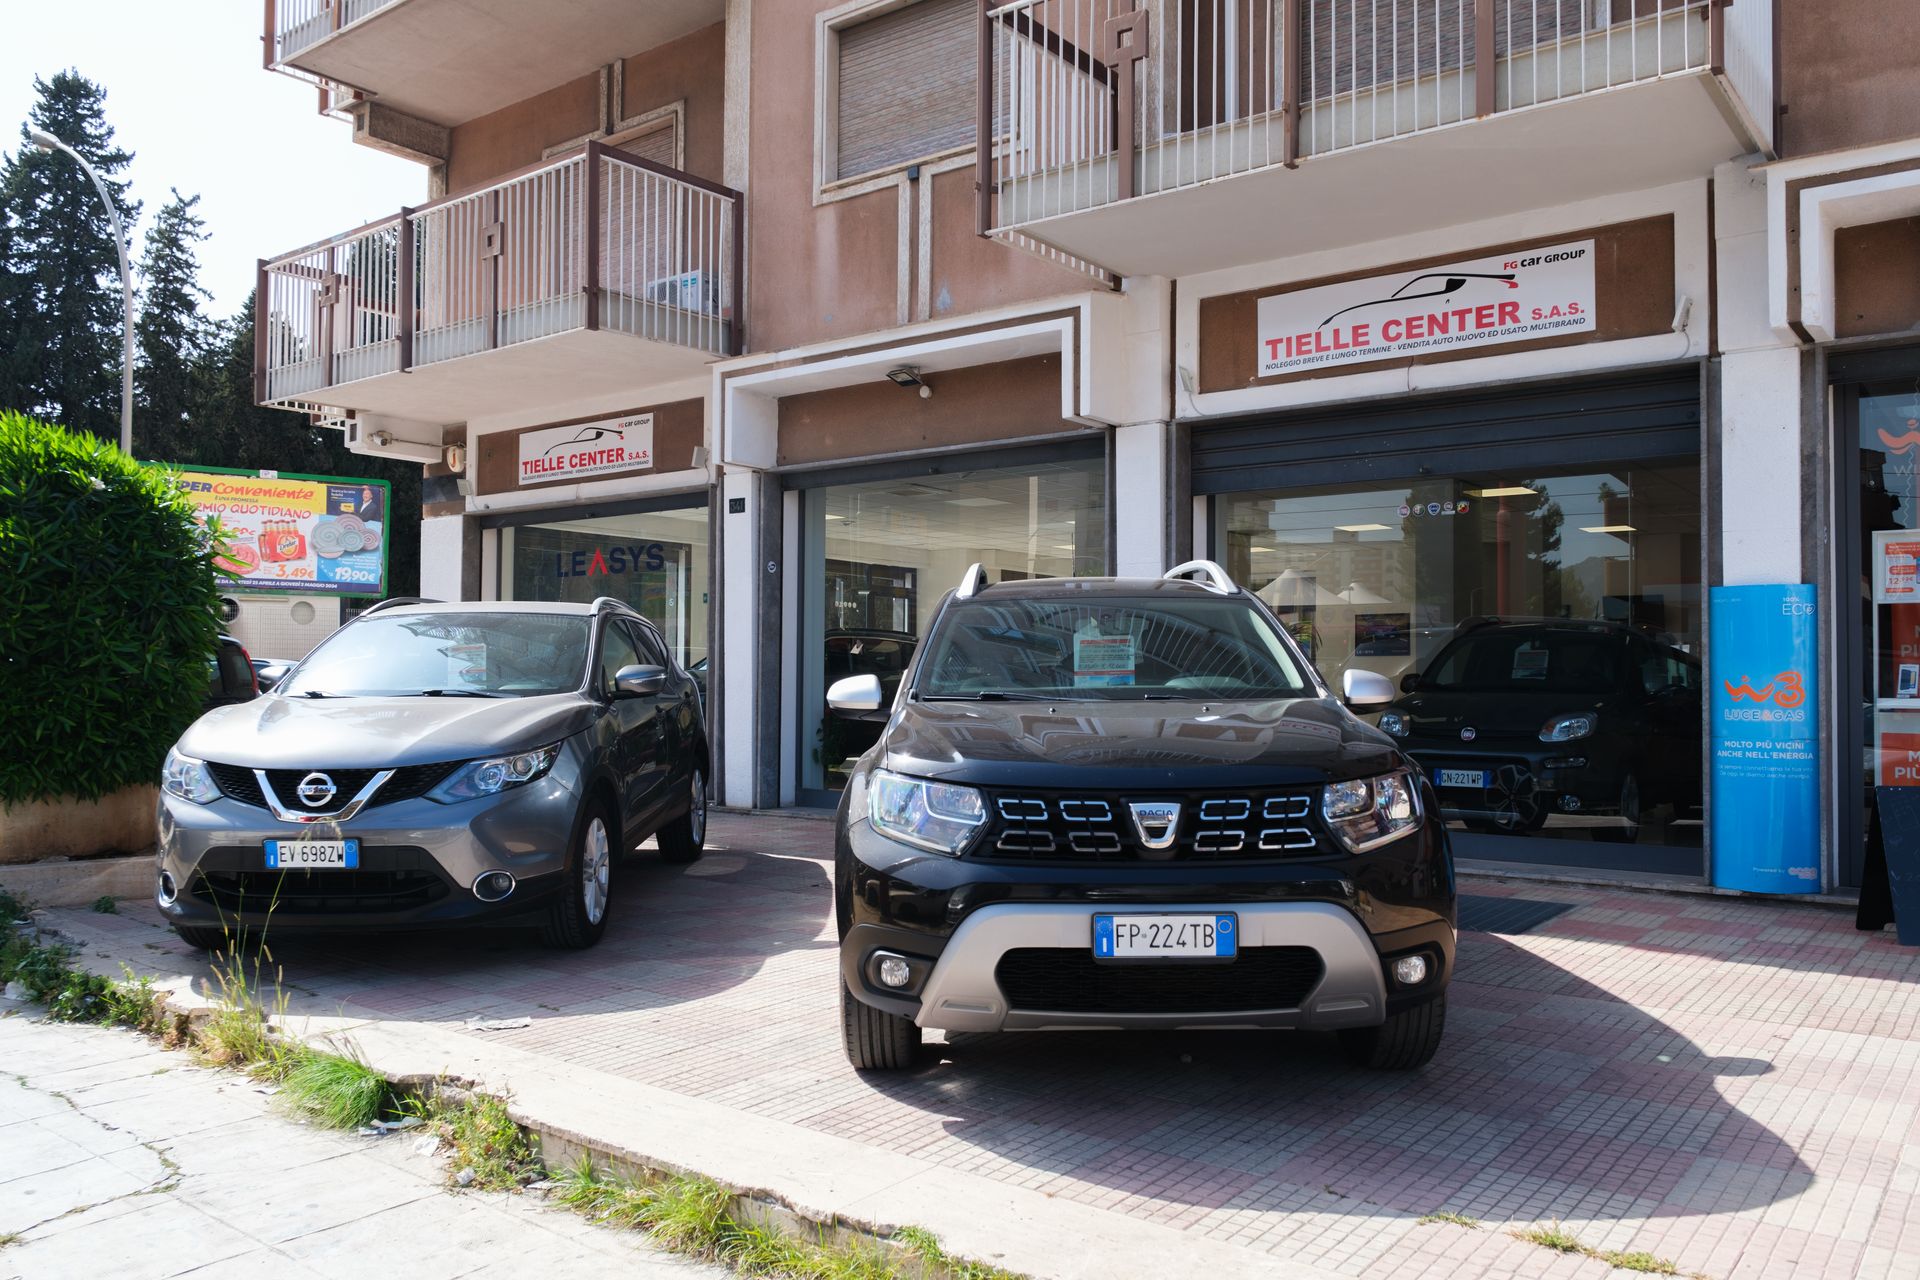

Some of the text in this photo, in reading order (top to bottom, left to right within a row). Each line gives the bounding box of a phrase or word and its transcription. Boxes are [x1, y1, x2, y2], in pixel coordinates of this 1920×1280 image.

[1503, 249, 1586, 270] FG car GROUP
[1265, 301, 1585, 361] TIELLE CENTER S.A.S.
[1265, 359, 1302, 371] NOLEGGIO
[1302, 355, 1324, 365] BREVE
[1331, 350, 1357, 360] LUNGO
[1359, 345, 1392, 356] TERMINE
[1398, 340, 1430, 351] VENDITA
[1432, 336, 1454, 346] AUTO
[1455, 332, 1486, 343] NUOVO
[1487, 330, 1499, 338] ED
[1500, 325, 1528, 336] USATO
[1529, 317, 1586, 332] MULTIBRAND
[522, 455, 565, 475] TIELLE
[569, 447, 625, 468] CENTER
[195, 502, 312, 519] EMIO QUOTIDIANO
[556, 543, 665, 577] LEASYS
[275, 564, 315, 579] 3,49€
[335, 567, 376, 582] 19,90€
[1724, 739, 1804, 750] MOLTO PIÙ VICINI
[1716, 750, 1814, 760] ANCHE NELL'ENERGIA
[1139, 809, 1174, 817] DACIA
[1116, 924, 1140, 948] FP
[1149, 924, 1214, 948] 224TB
